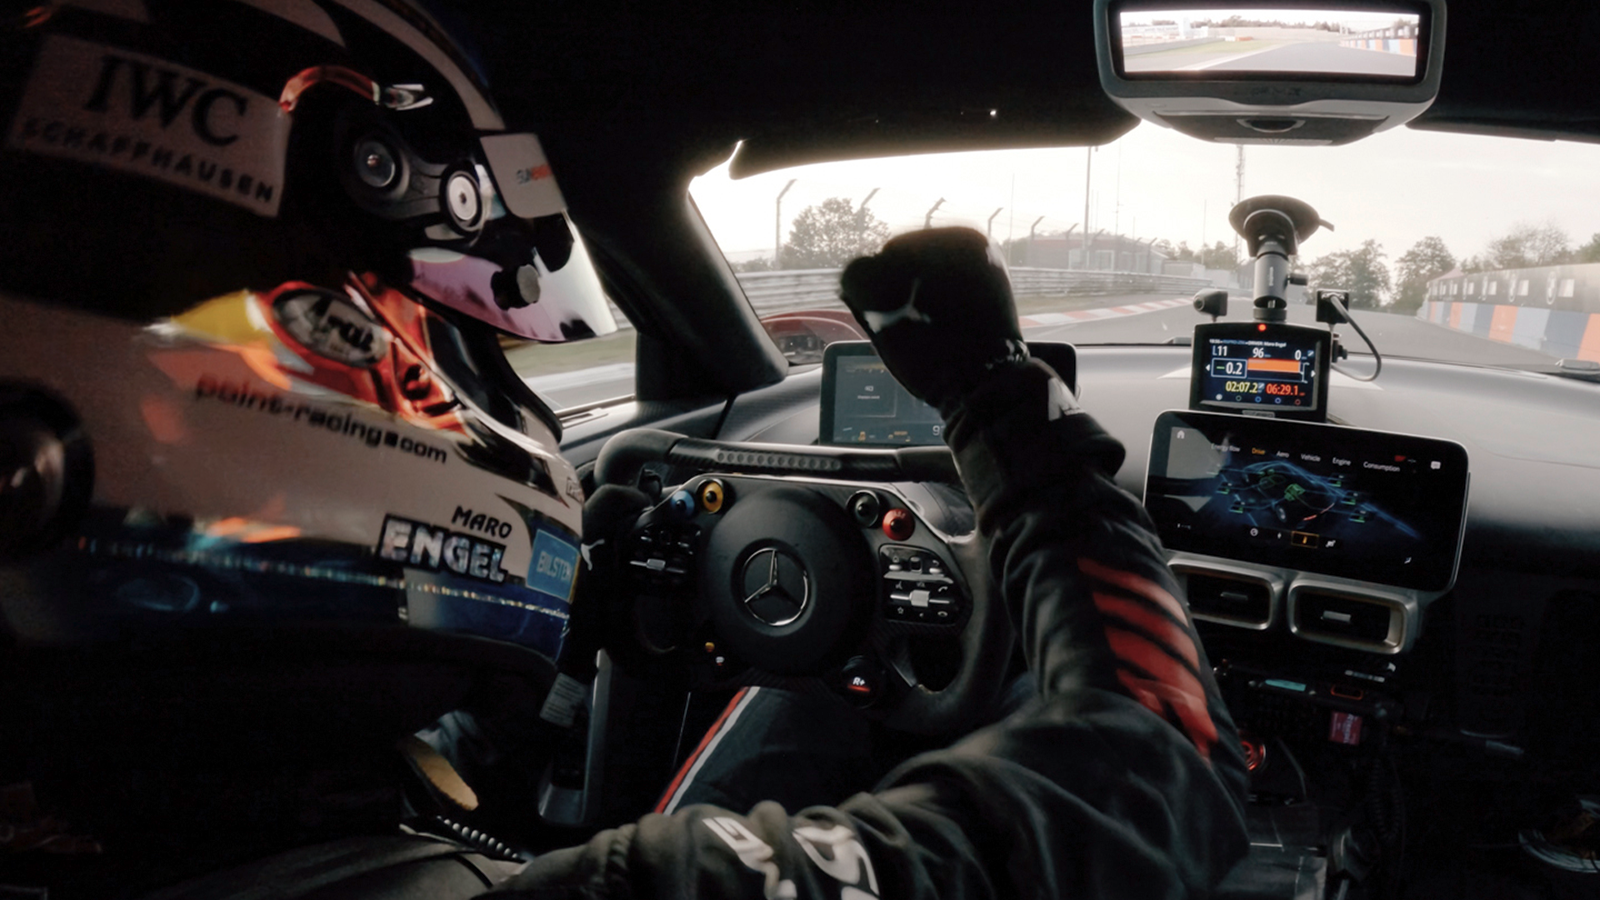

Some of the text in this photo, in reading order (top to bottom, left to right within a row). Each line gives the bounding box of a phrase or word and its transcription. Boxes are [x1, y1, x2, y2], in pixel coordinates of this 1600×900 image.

[82, 54, 248, 147] IWC
[23, 117, 274, 204] SCHAFFHAUSEN
[1252, 347, 1264, 359] 96
[1294, 349, 1302, 361] 0
[1225, 381, 1299, 396] 02:07.2 06:29.1
[1251, 447, 1266, 455] Drive
[1276, 450, 1289, 459] Aero
[1300, 453, 1321, 462] Vehicle
[1332, 457, 1352, 467] Engine
[1363, 461, 1400, 472] Consumption
[452, 505, 512, 538] MARO
[380, 518, 505, 582] ENGEL
